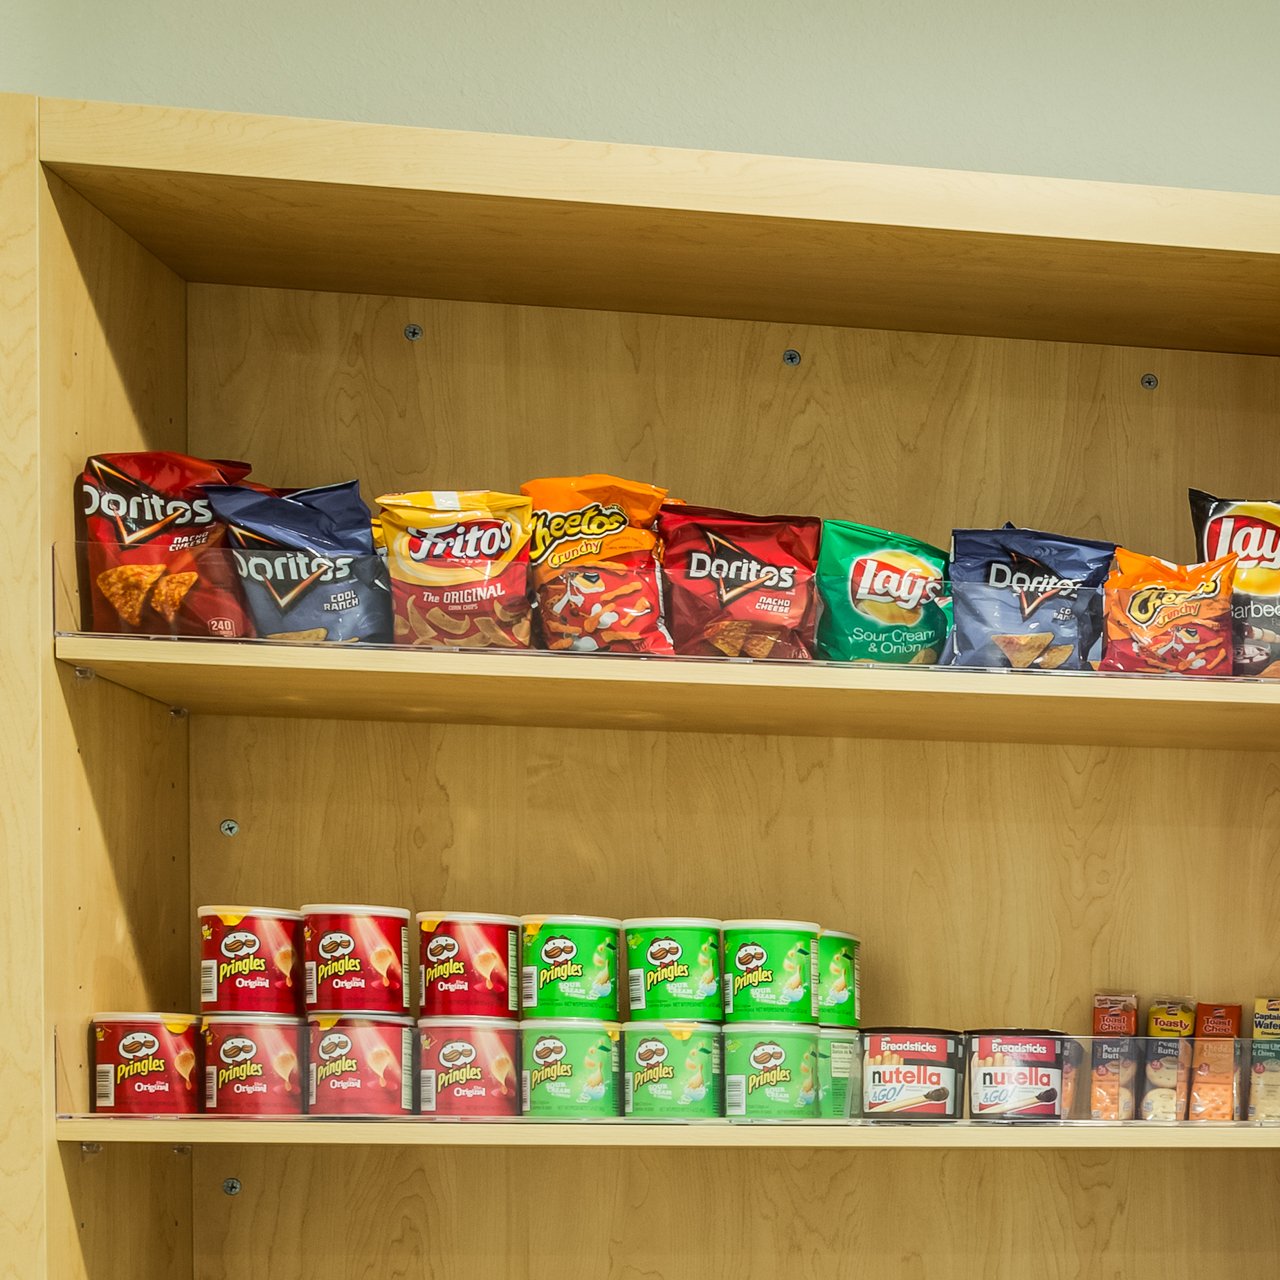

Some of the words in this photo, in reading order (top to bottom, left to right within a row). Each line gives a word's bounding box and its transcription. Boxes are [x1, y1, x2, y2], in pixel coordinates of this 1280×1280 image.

[407, 520, 512, 562] Fritos
[548, 542, 599, 567] Crunchy
[690, 552, 795, 588] Doritos
[856, 559, 942, 609] Lay's
[330, 591, 356, 602] COOL
[423, 592, 440, 603] The
[443, 583, 505, 604] ORIGINAL
[759, 597, 790, 606] NACHO
[324, 598, 359, 611] RANCH
[755, 603, 790, 613] CHEESE
[853, 627, 888, 642] Sour
[895, 628, 935, 642] Cream
[868, 642, 878, 653] &
[880, 641, 921, 654] Onion
[219, 956, 266, 984] Pringles
[318, 956, 361, 985] Pringles
[426, 959, 464, 986] Pringles
[539, 963, 582, 988] Pringles
[647, 964, 689, 991] Pringles
[235, 978, 270, 989] Original
[333, 978, 365, 989] Original
[438, 980, 468, 991] Original
[734, 968, 773, 995] Pringles
[1100, 1015, 1126, 1024] Toast
[1100, 1023, 1126, 1031] Chee
[1153, 1019, 1189, 1029] Toasty
[1203, 1017, 1232, 1026] Toast
[1203, 1025, 1231, 1033] Chee
[881, 1041, 936, 1052] Breadsticks
[992, 1043, 1046, 1054] Breadsticks
[116, 1056, 165, 1084] Pringles
[219, 1061, 263, 1084] Pringles
[317, 1057, 357, 1086] Pringles
[531, 1062, 572, 1090] Pringles
[634, 1063, 674, 1092] Pringles
[872, 1066, 941, 1086] nutella
[983, 1068, 1050, 1086] nutella
[330, 1078, 361, 1089] Original
[438, 1064, 482, 1093] Pringles
[749, 1065, 790, 1093] Pringles
[134, 1082, 169, 1092] Original
[234, 1083, 267, 1094] Original
[453, 1086, 486, 1097] Original
